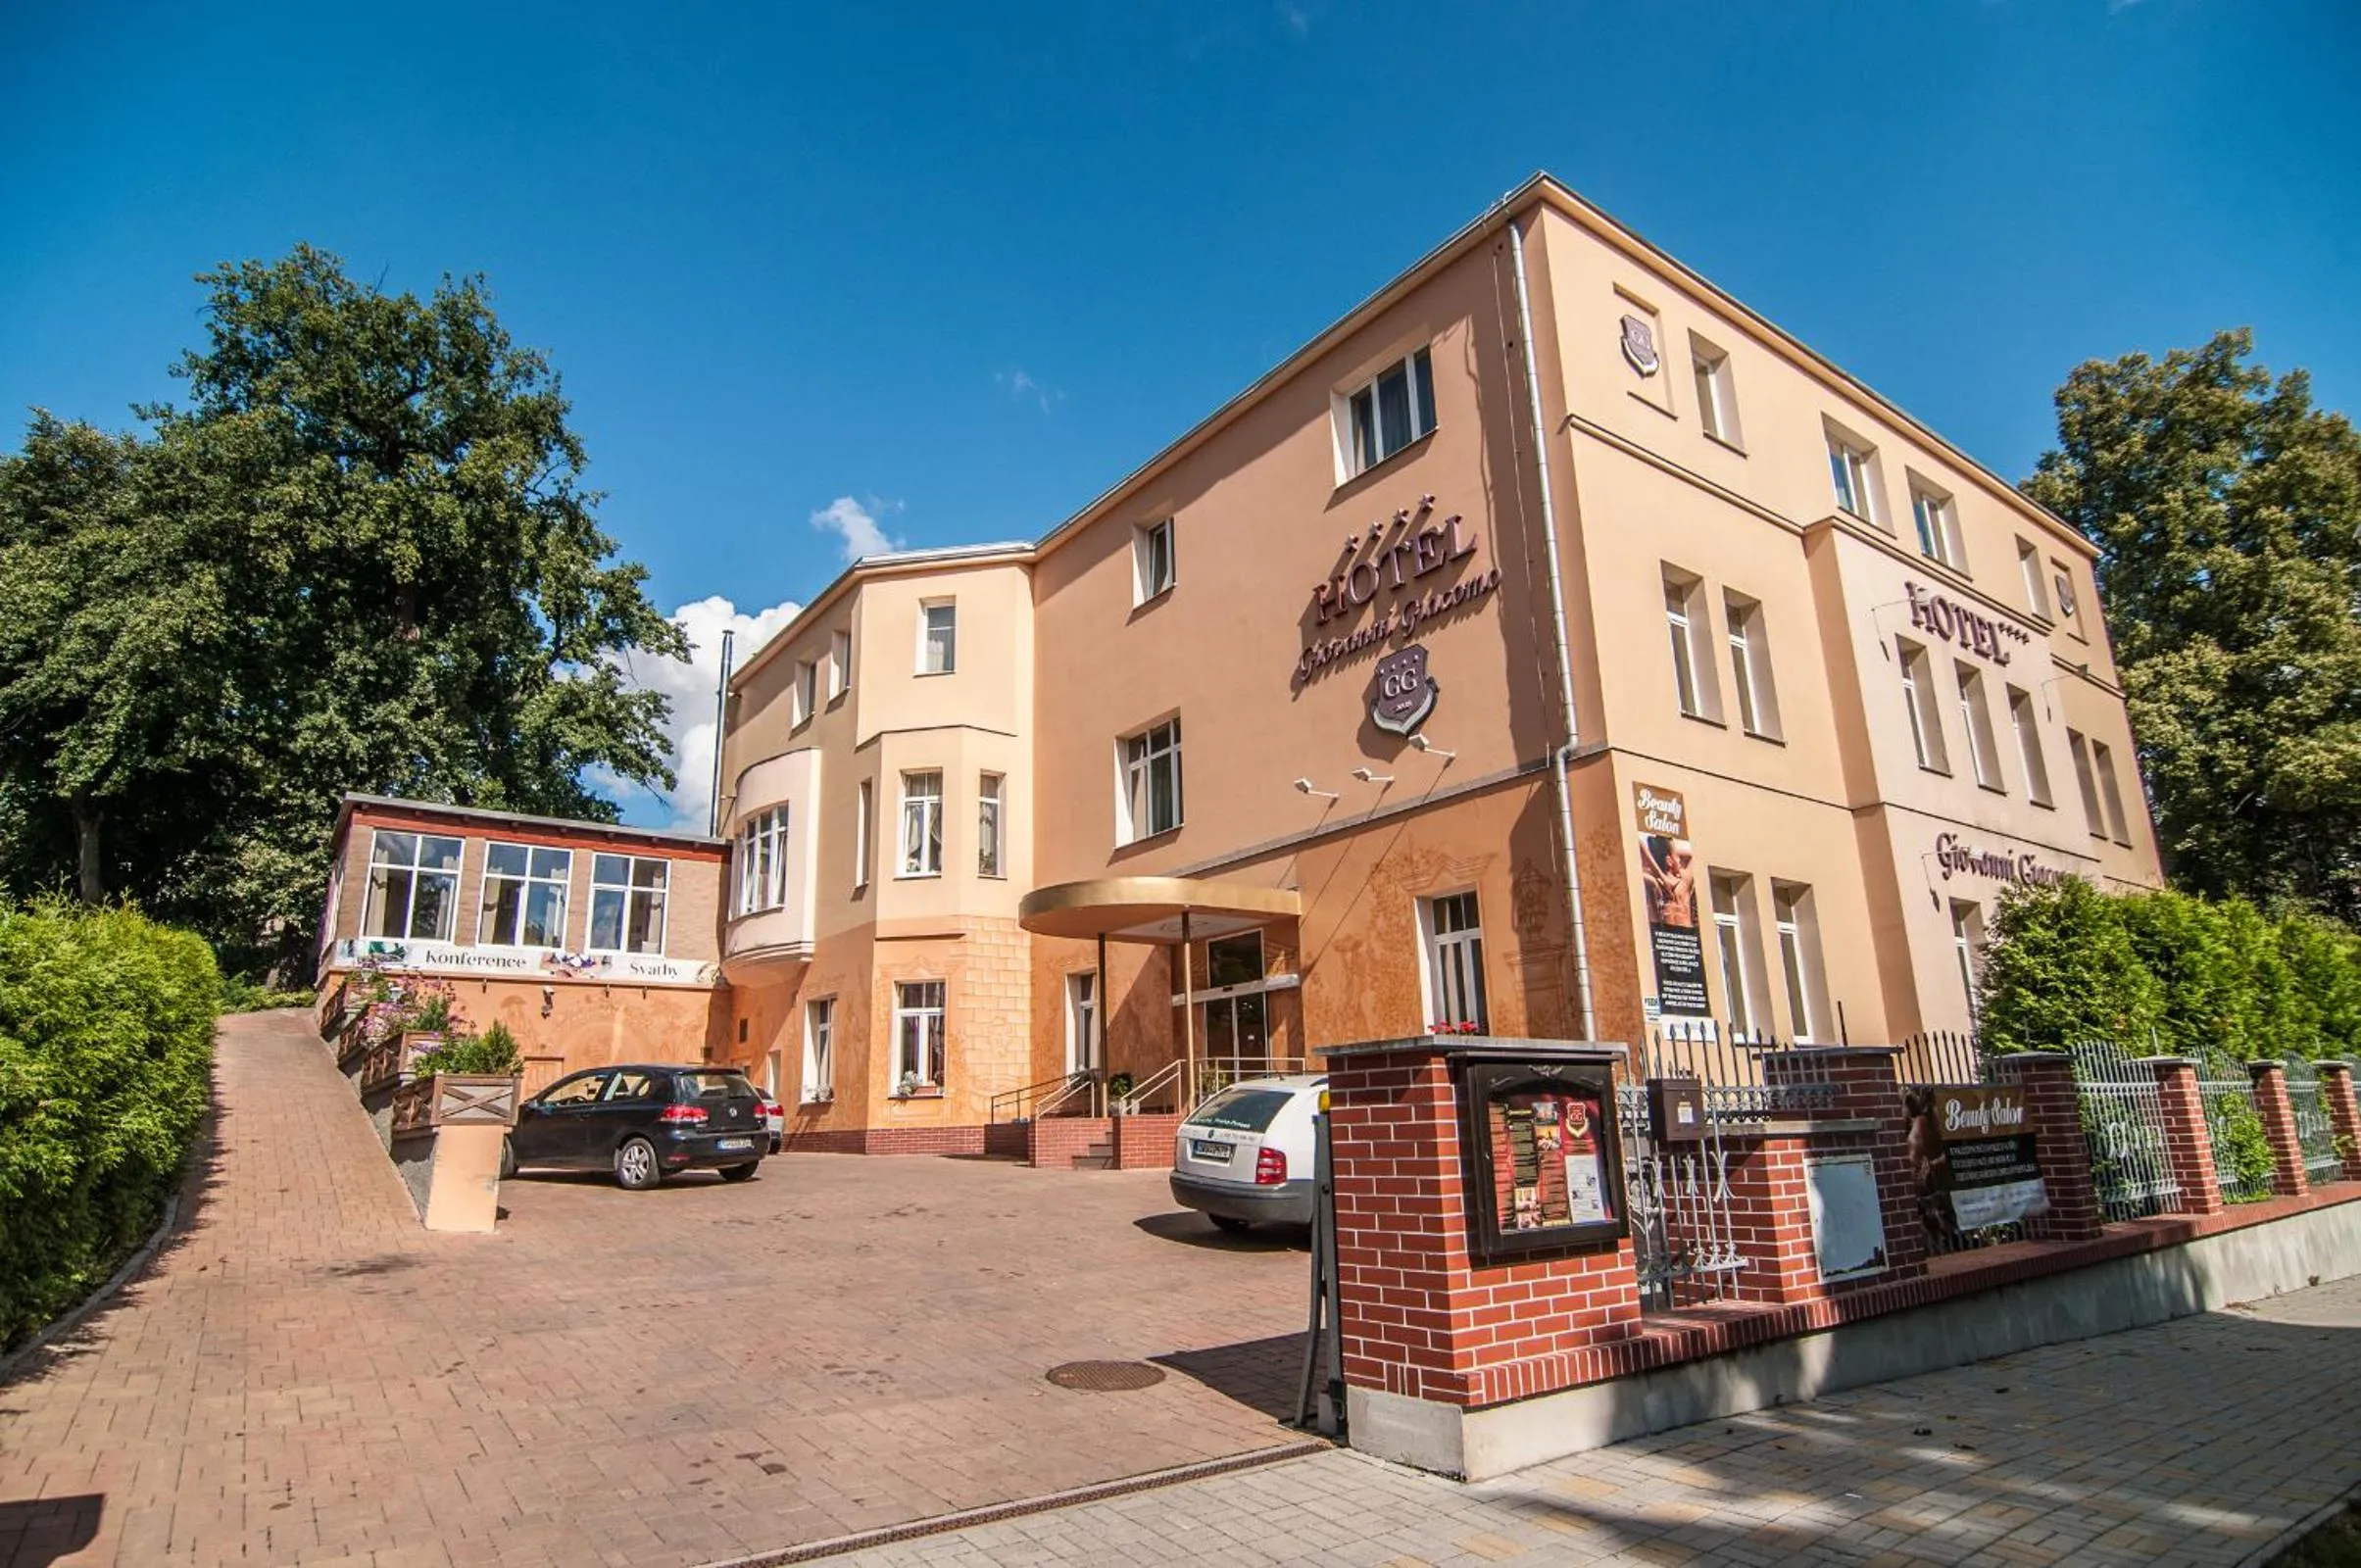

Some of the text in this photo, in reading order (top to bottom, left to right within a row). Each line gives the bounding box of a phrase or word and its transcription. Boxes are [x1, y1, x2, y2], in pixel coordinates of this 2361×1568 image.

[1311, 514, 1478, 625] HOTEL
[1904, 581, 2010, 667] HOTEL
[1385, 667, 1417, 697] GG
[1638, 788, 1682, 820] Beauty
[1645, 809, 1680, 835] Salon
[425, 950, 527, 968] Konference
[1944, 1099, 1991, 1134] Beauty
